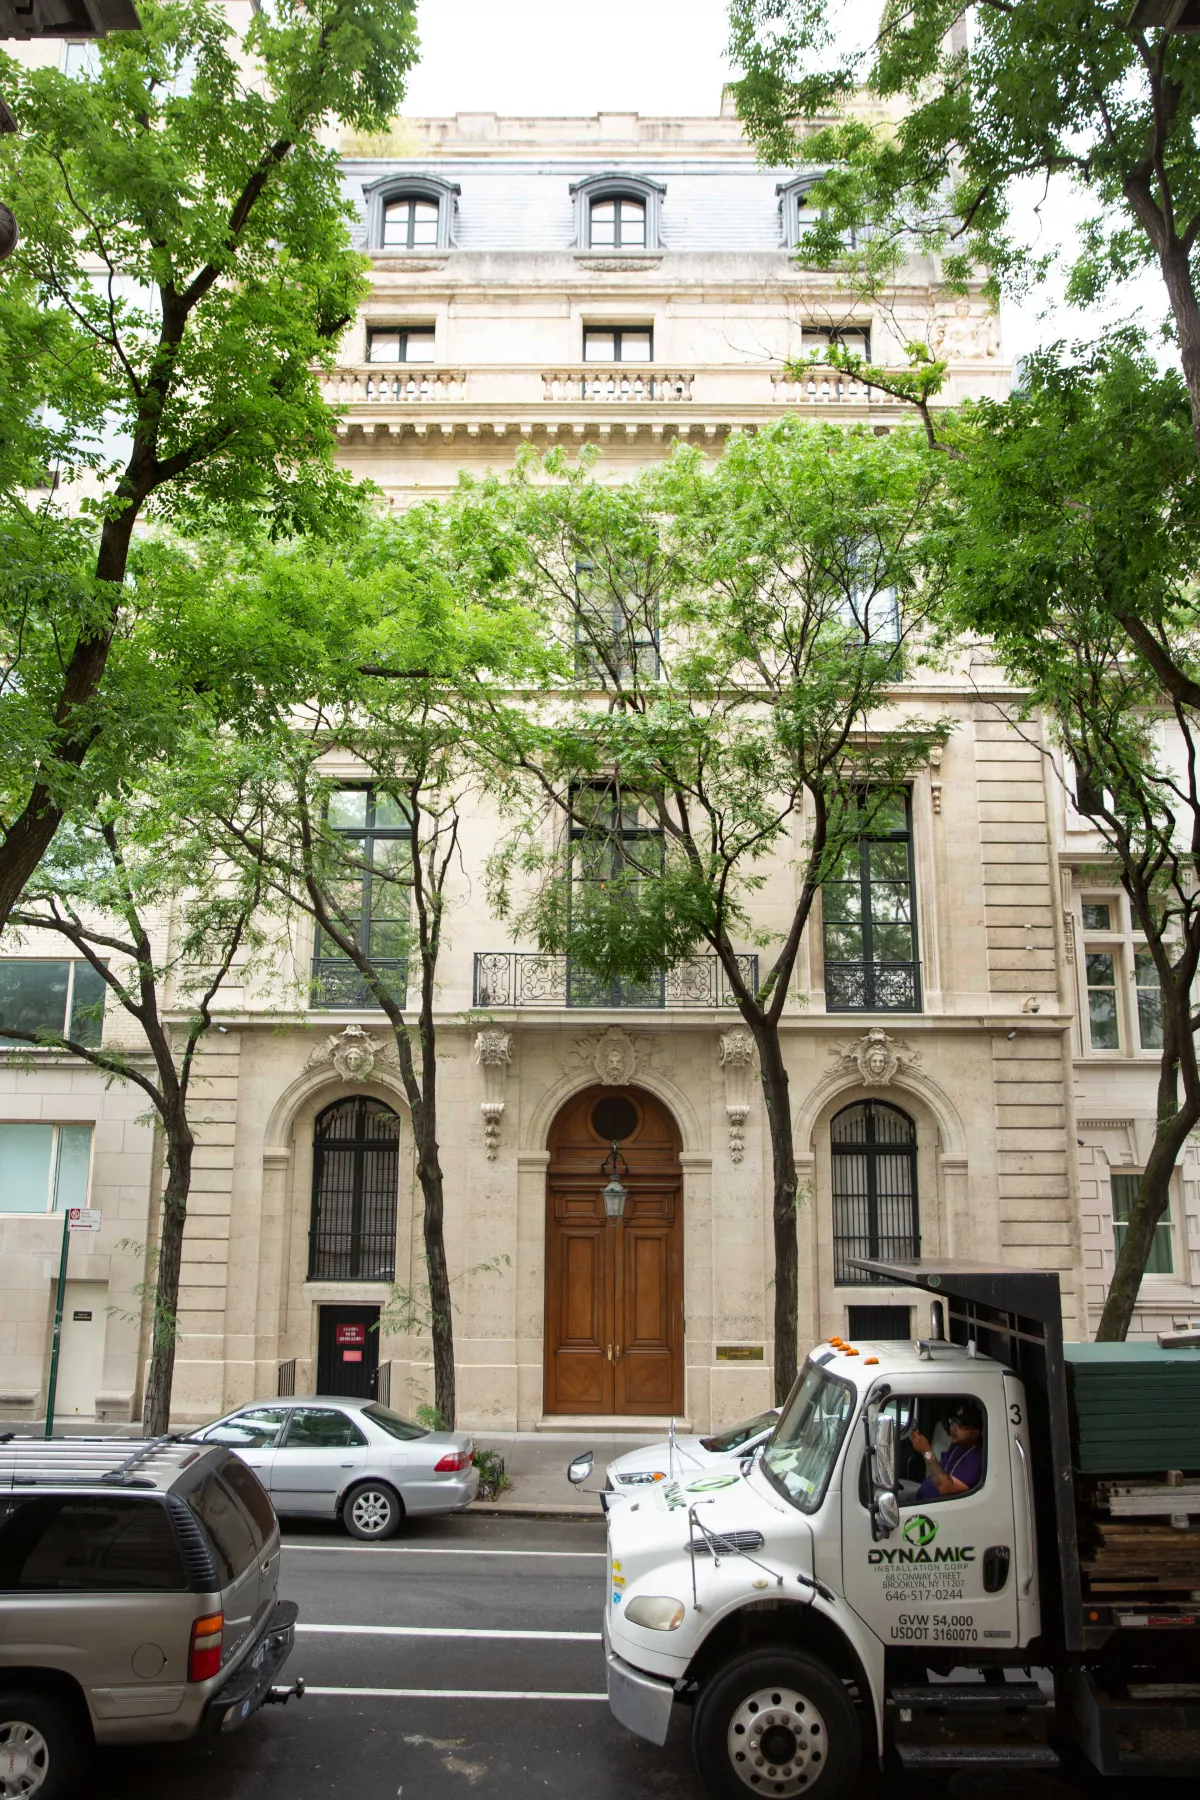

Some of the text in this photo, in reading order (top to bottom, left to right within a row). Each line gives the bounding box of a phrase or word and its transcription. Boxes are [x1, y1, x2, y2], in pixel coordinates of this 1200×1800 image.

[1009, 1403, 1022, 1425] 3
[868, 1546, 976, 1564] DYNAMIC
[874, 1563, 972, 1572] INSTALLATION CORP.
[885, 1572, 962, 1581] 68 CONWAY STREET
[882, 1580, 965, 1589] BROOKLYN, NY 11207
[885, 1589, 963, 1601] 646-517-0244
[898, 1614, 974, 1628] GVW 54,000
[890, 1626, 929, 1640] USDOT
[933, 1628, 978, 1641] 3160070
